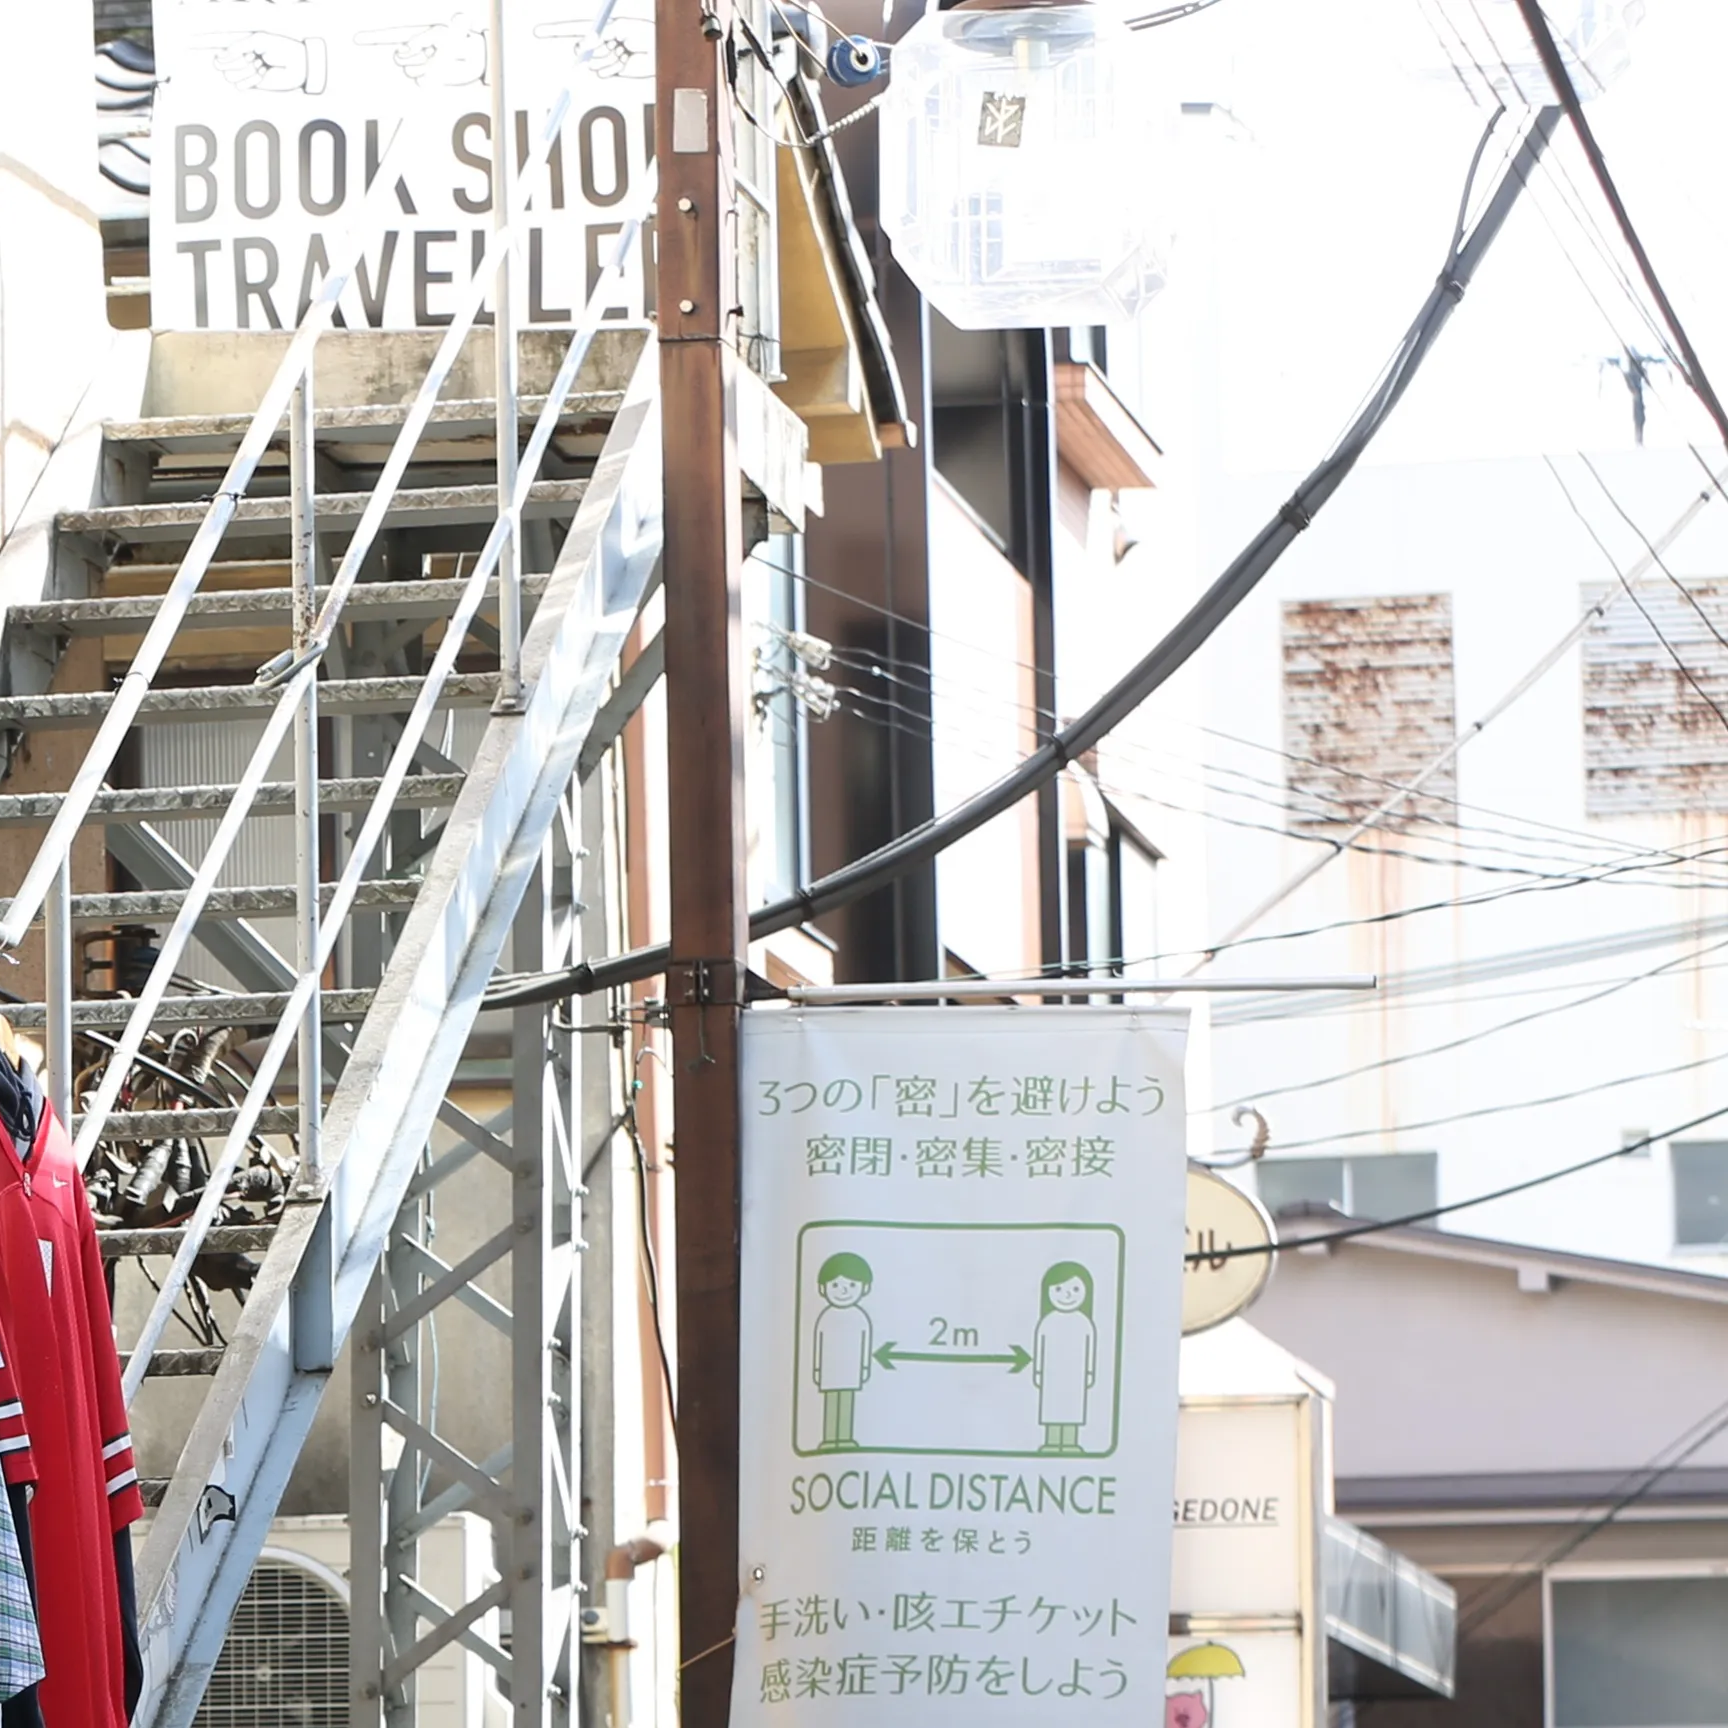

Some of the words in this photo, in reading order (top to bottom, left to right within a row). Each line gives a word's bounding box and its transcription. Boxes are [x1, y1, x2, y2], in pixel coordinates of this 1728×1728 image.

[174, 117, 417, 223] BOOK
[452, 103, 656, 212] SHO
[176, 217, 657, 328] TRAVELLE
[757, 1074, 1166, 1119] 3つの「密」を避けよう
[805, 1133, 1117, 1179] 密閉・密集・密接
[928, 1317, 980, 1347] 2m
[790, 1470, 919, 1515] SOCIAL
[929, 1473, 1117, 1515] DISTANCE
[851, 1526, 1034, 1555] 距離を保とう
[759, 1591, 1138, 1641] 手洗い・咳エチケット
[759, 1653, 1129, 1704] 感染症予防をしよう
